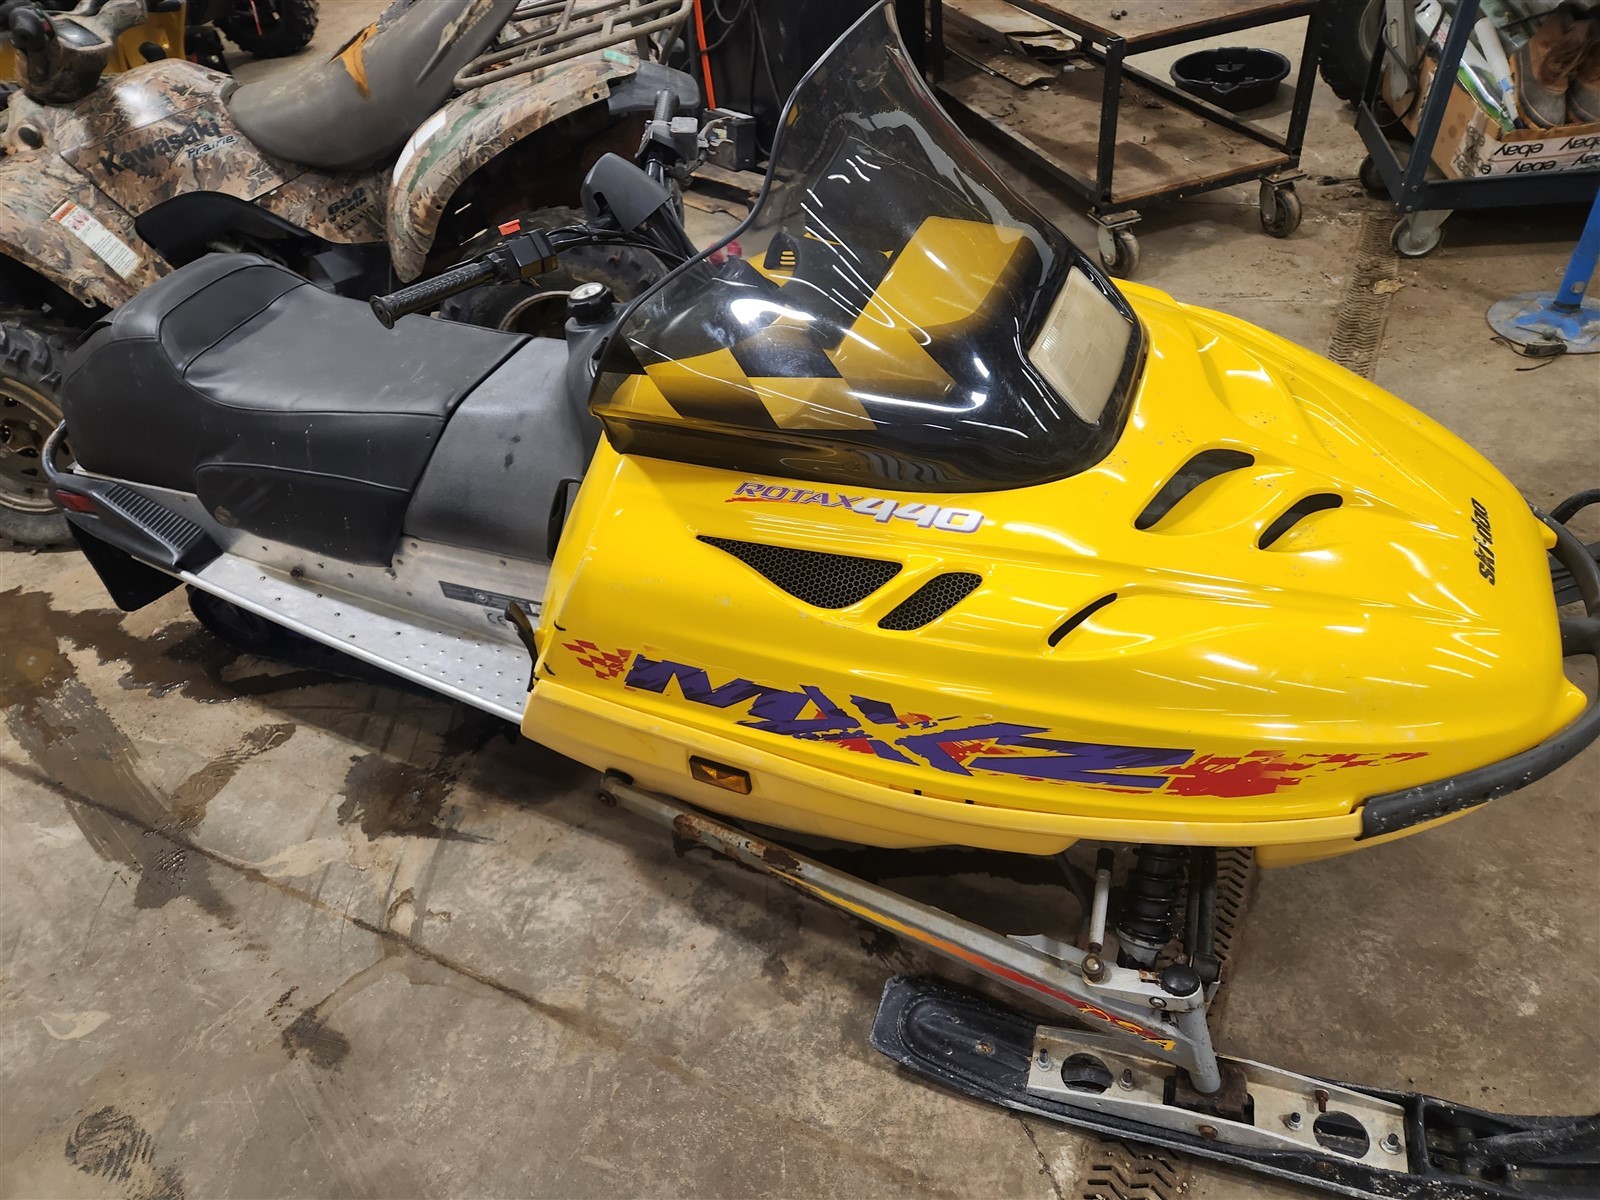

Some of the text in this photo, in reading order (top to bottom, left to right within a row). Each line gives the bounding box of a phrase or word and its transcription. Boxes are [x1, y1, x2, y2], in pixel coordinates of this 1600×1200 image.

[99, 118, 221, 176] Kawasaki
[187, 135, 236, 158] Prairie
[1493, 143, 1544, 157] ebay
[733, 481, 985, 534] ROTAX 440
